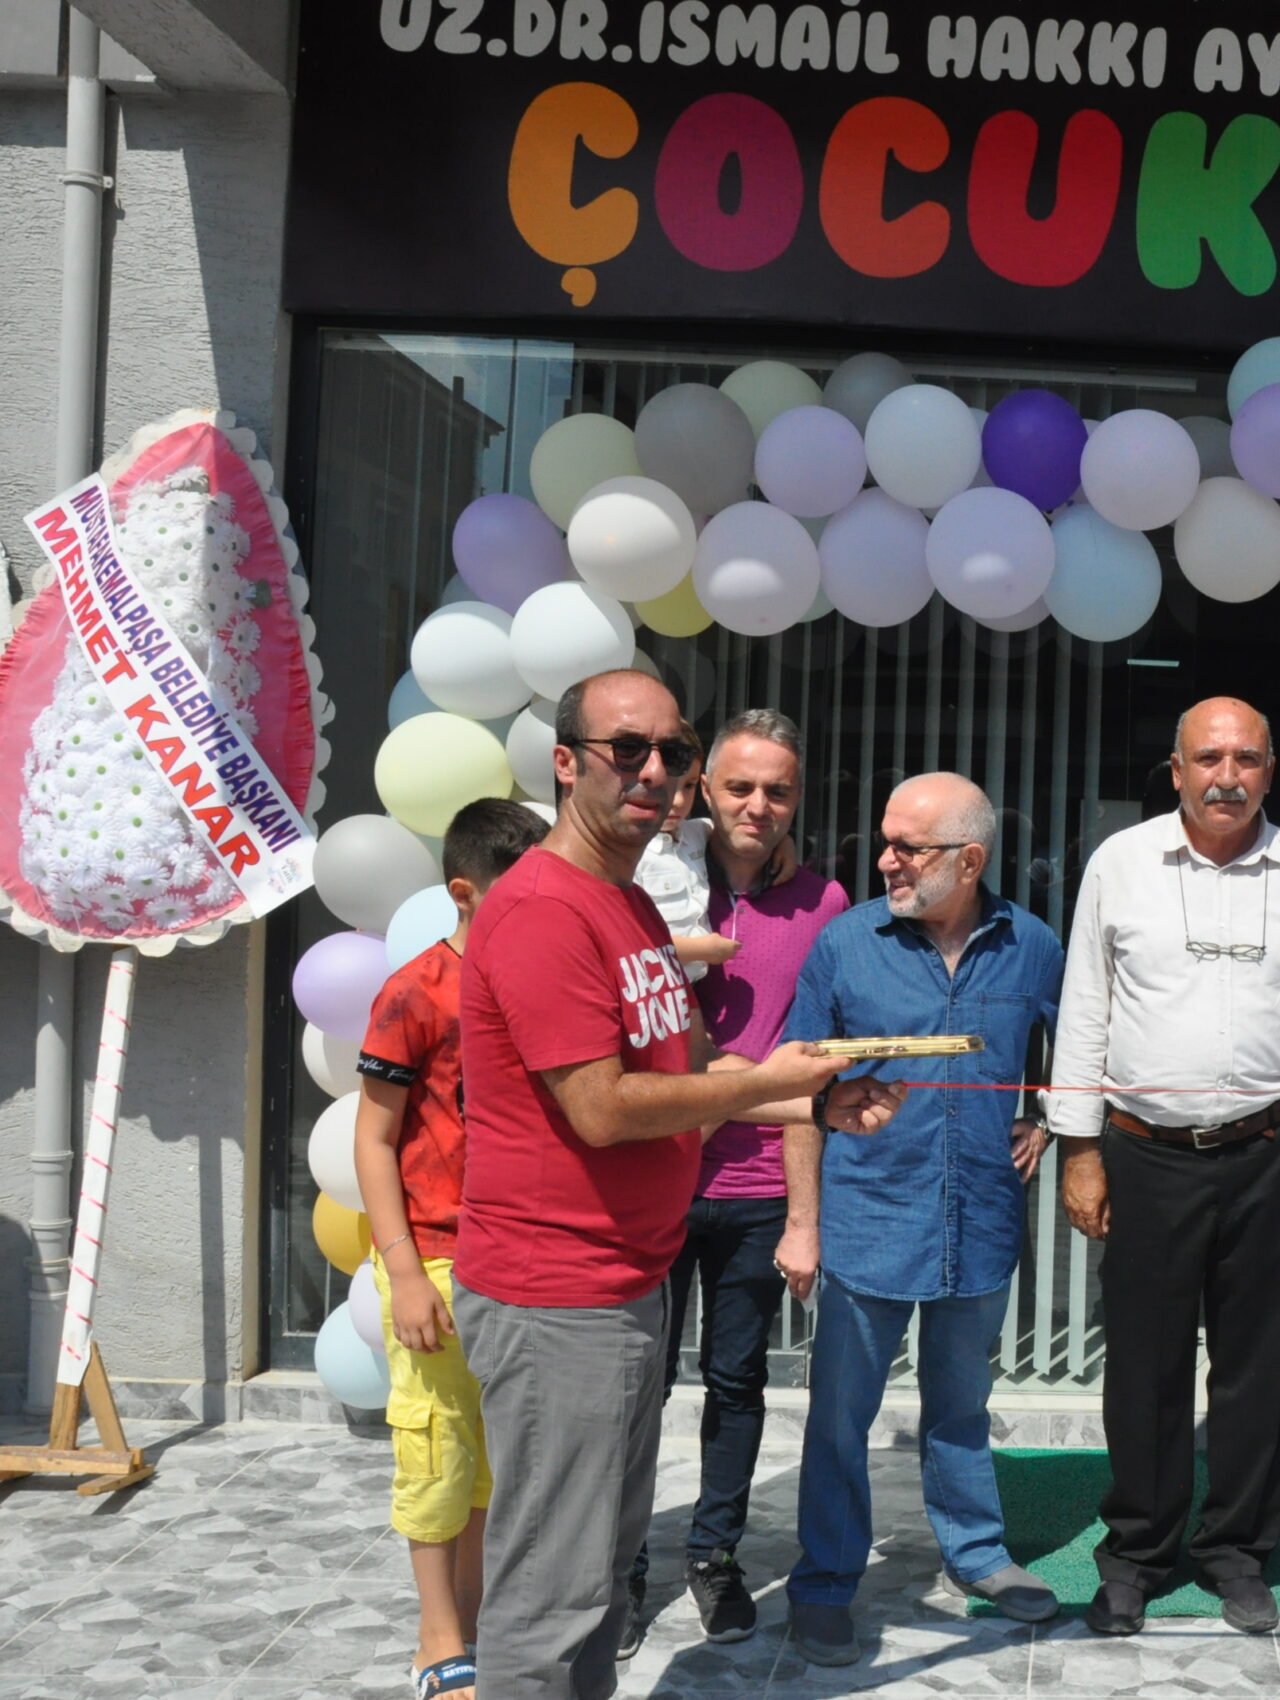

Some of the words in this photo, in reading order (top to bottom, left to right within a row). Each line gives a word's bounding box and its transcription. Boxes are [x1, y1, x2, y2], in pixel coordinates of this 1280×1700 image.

[927, 15, 1168, 89] HAKKI
[35, 507, 138, 685] MEHMET
[124, 693, 261, 878] KANAR
[70, 485, 172, 666] MUSTAFAKEMALPAŞA
[150, 656, 241, 762] BELEDİYE
[216, 752, 302, 854] BAŞKANI
